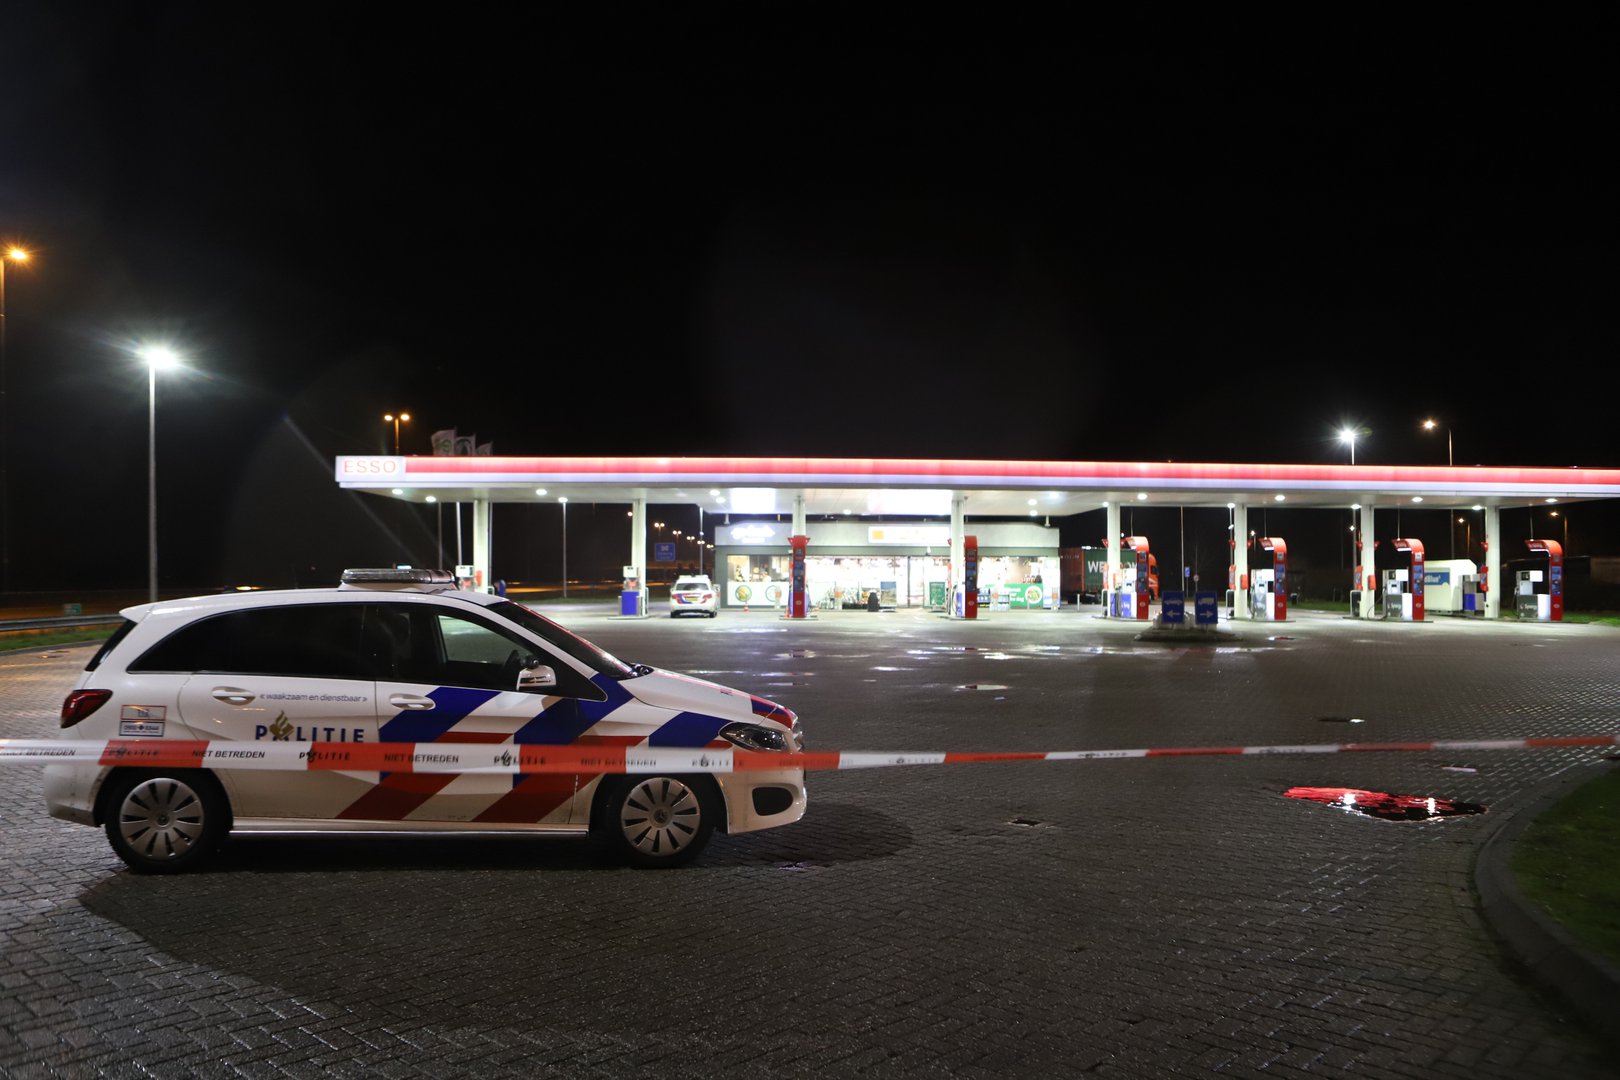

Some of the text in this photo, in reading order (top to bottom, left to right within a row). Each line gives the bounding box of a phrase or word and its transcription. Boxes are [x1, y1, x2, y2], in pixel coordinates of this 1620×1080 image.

[344, 460, 396, 473] ESSO
[320, 694, 361, 702] dienstbaar
[214, 751, 265, 759] BETREDEN
[384, 753, 406, 762] NIET
[408, 754, 459, 763] BETREDEN
